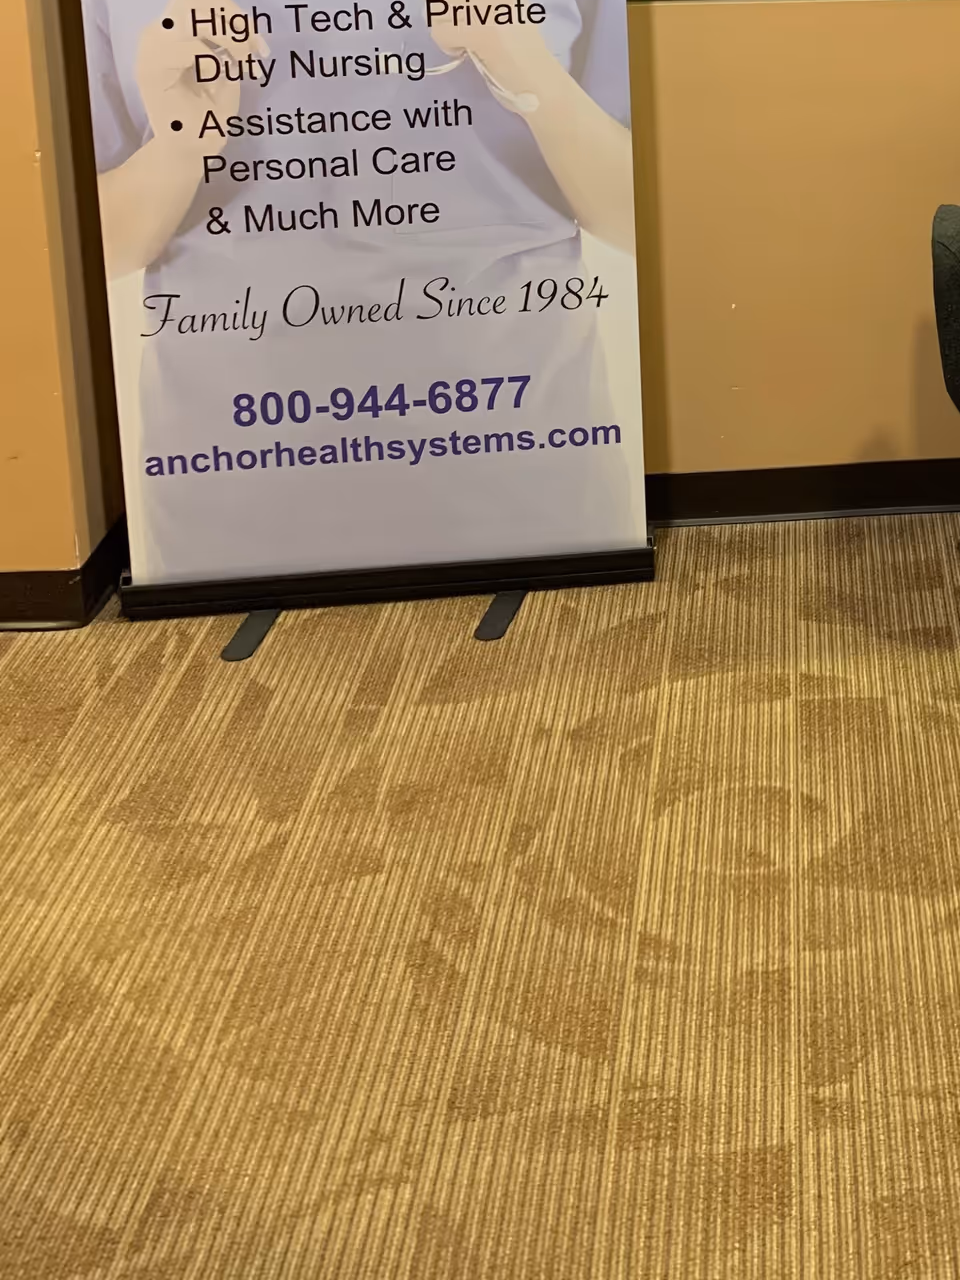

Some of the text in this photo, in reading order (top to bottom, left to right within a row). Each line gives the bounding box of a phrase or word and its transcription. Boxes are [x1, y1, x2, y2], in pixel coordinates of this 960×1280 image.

[190, 5, 273, 42] High
[285, 2, 374, 34] Tech
[387, 0, 413, 30] &
[194, 48, 426, 87] Duty Nursing
[198, 98, 474, 139] Assistance with
[202, 146, 456, 184] Personal Care
[205, 198, 440, 235] & Much More
[140, 275, 609, 341] Family Owned Since 1984
[232, 376, 532, 427] 800-944-6877
[144, 423, 622, 477] anchorhealthsystems.com
